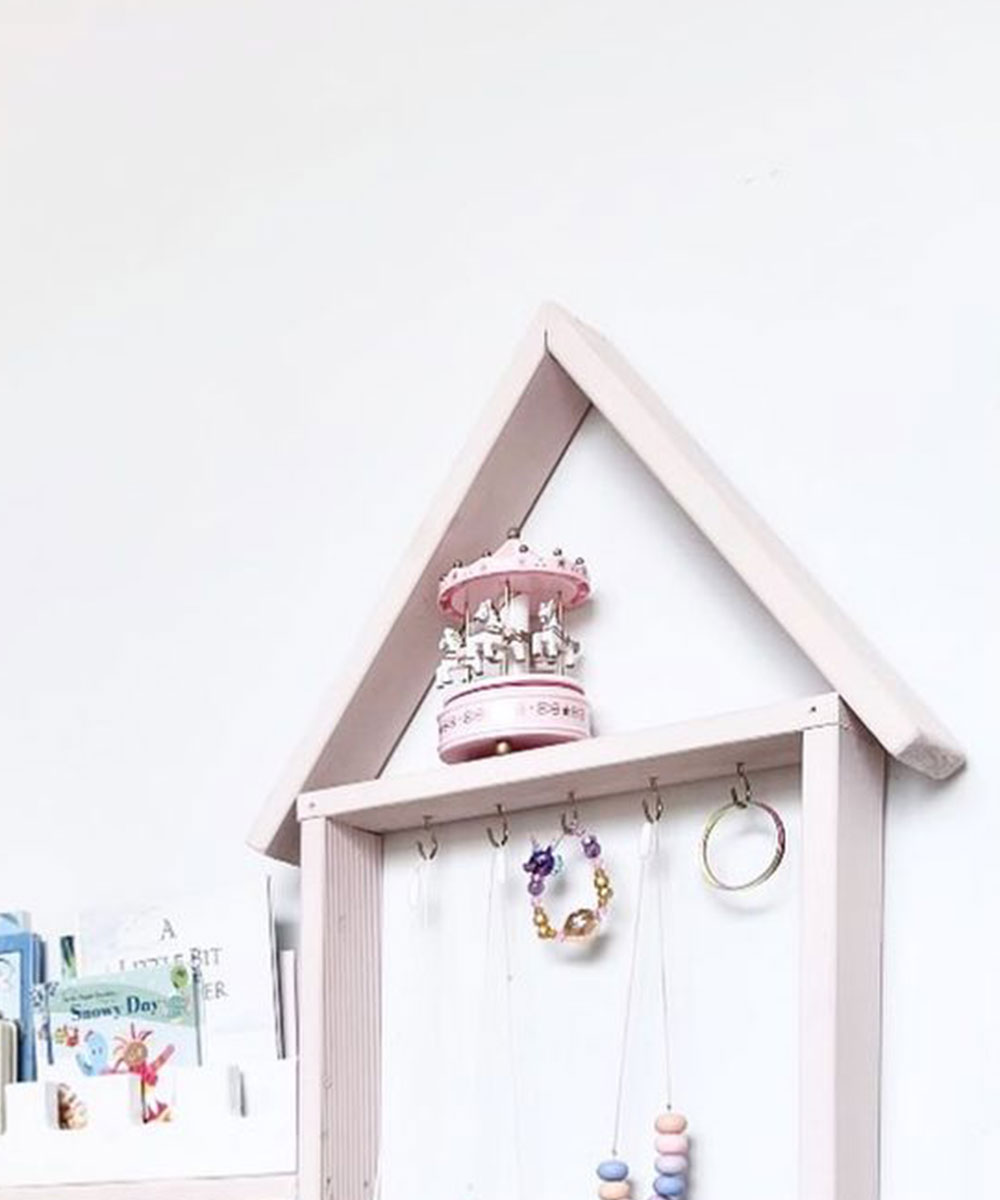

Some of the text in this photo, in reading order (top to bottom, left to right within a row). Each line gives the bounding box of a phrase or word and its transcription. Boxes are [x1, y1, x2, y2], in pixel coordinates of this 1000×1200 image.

[160, 918, 177, 941] A
[188, 947, 224, 968] BIT
[70, 1002, 122, 1021] Snowy
[125, 995, 159, 1017] Day
